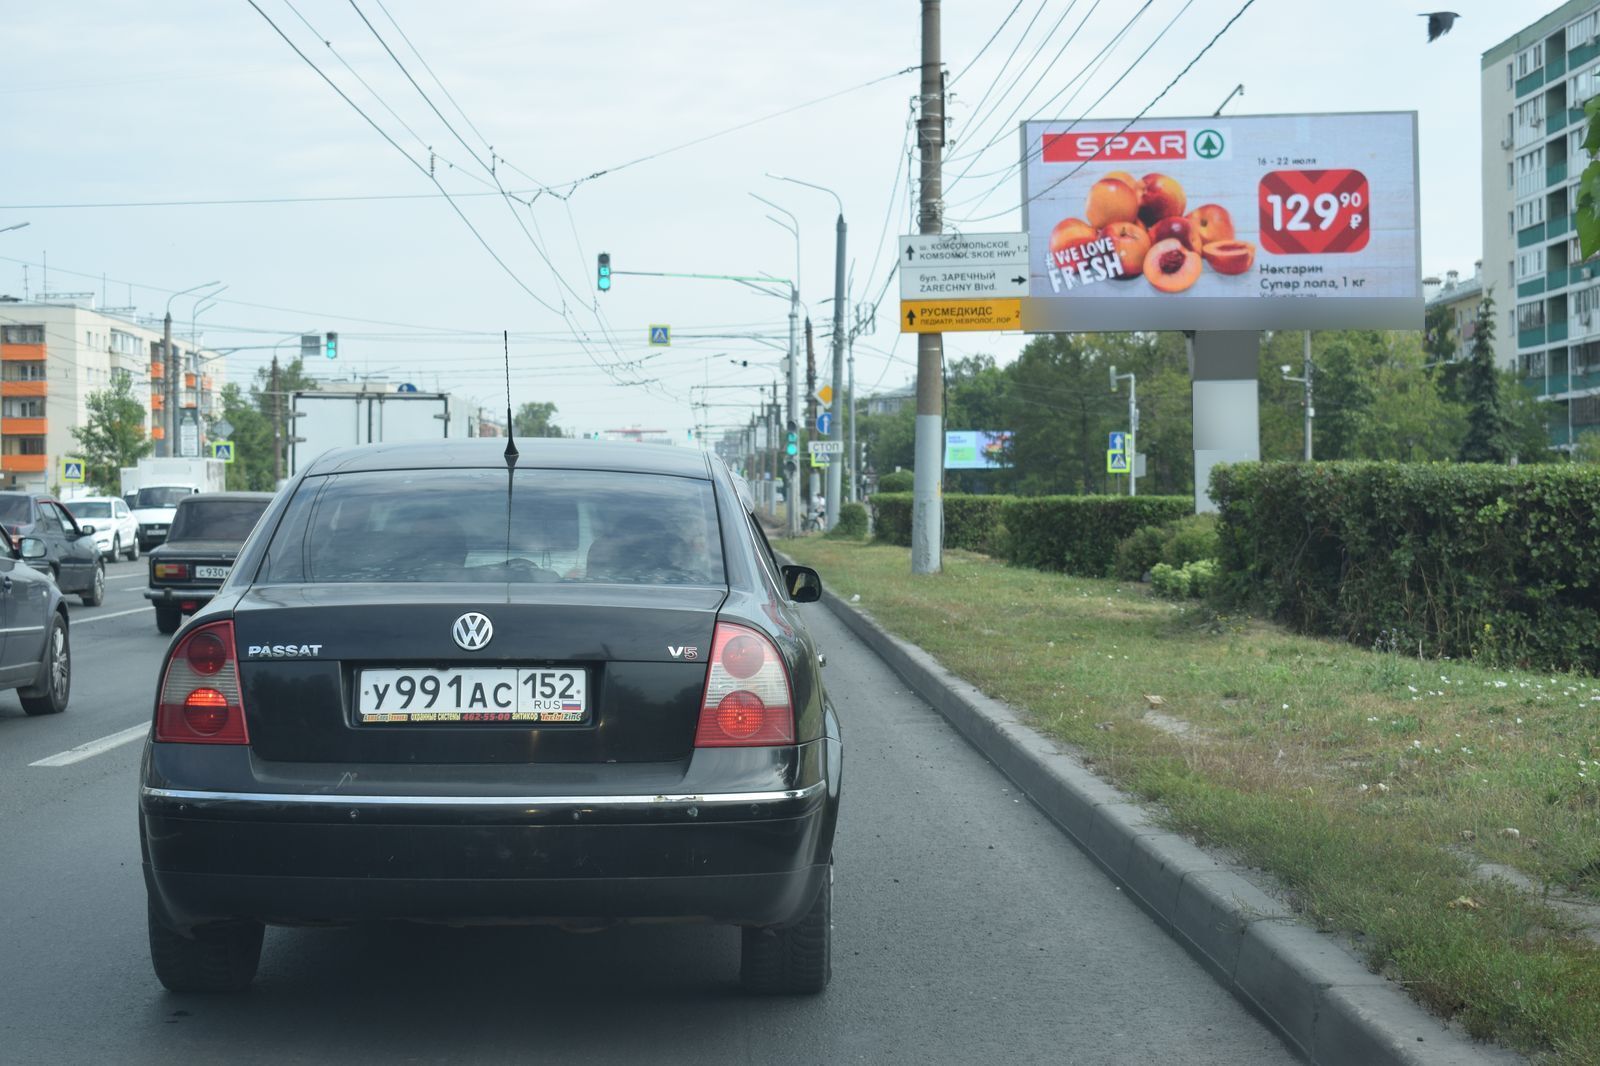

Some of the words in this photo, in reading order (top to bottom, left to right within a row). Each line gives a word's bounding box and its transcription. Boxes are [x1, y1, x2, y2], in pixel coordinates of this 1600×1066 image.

[1076, 135, 1184, 157] SPAR
[1258, 158, 1267, 166] 16
[1277, 157, 1289, 165] 22
[1267, 192, 1339, 231] 129
[1340, 192, 1361, 208] 90
[931, 241, 1009, 251] КОМСОМОЛЬСКОЕ
[1080, 237, 1115, 257] LOVE
[997, 250, 1016, 258] HWY
[942, 271, 996, 281] ЗАРЕЧНЫЙ
[1048, 252, 1124, 293] FRESH
[1260, 264, 1323, 276] Нектарин
[920, 283, 972, 293] ZARECHNY
[1260, 278, 1300, 291] Супер
[1342, 276, 1347, 287] 1
[1352, 279, 1365, 287] кг
[921, 306, 993, 317] РУСМЕДКИДС
[814, 443, 839, 452] СТОП
[248, 644, 322, 657] PASSAT
[668, 646, 698, 660] V5
[522, 673, 575, 699] 152
[534, 700, 561, 710] RUS
